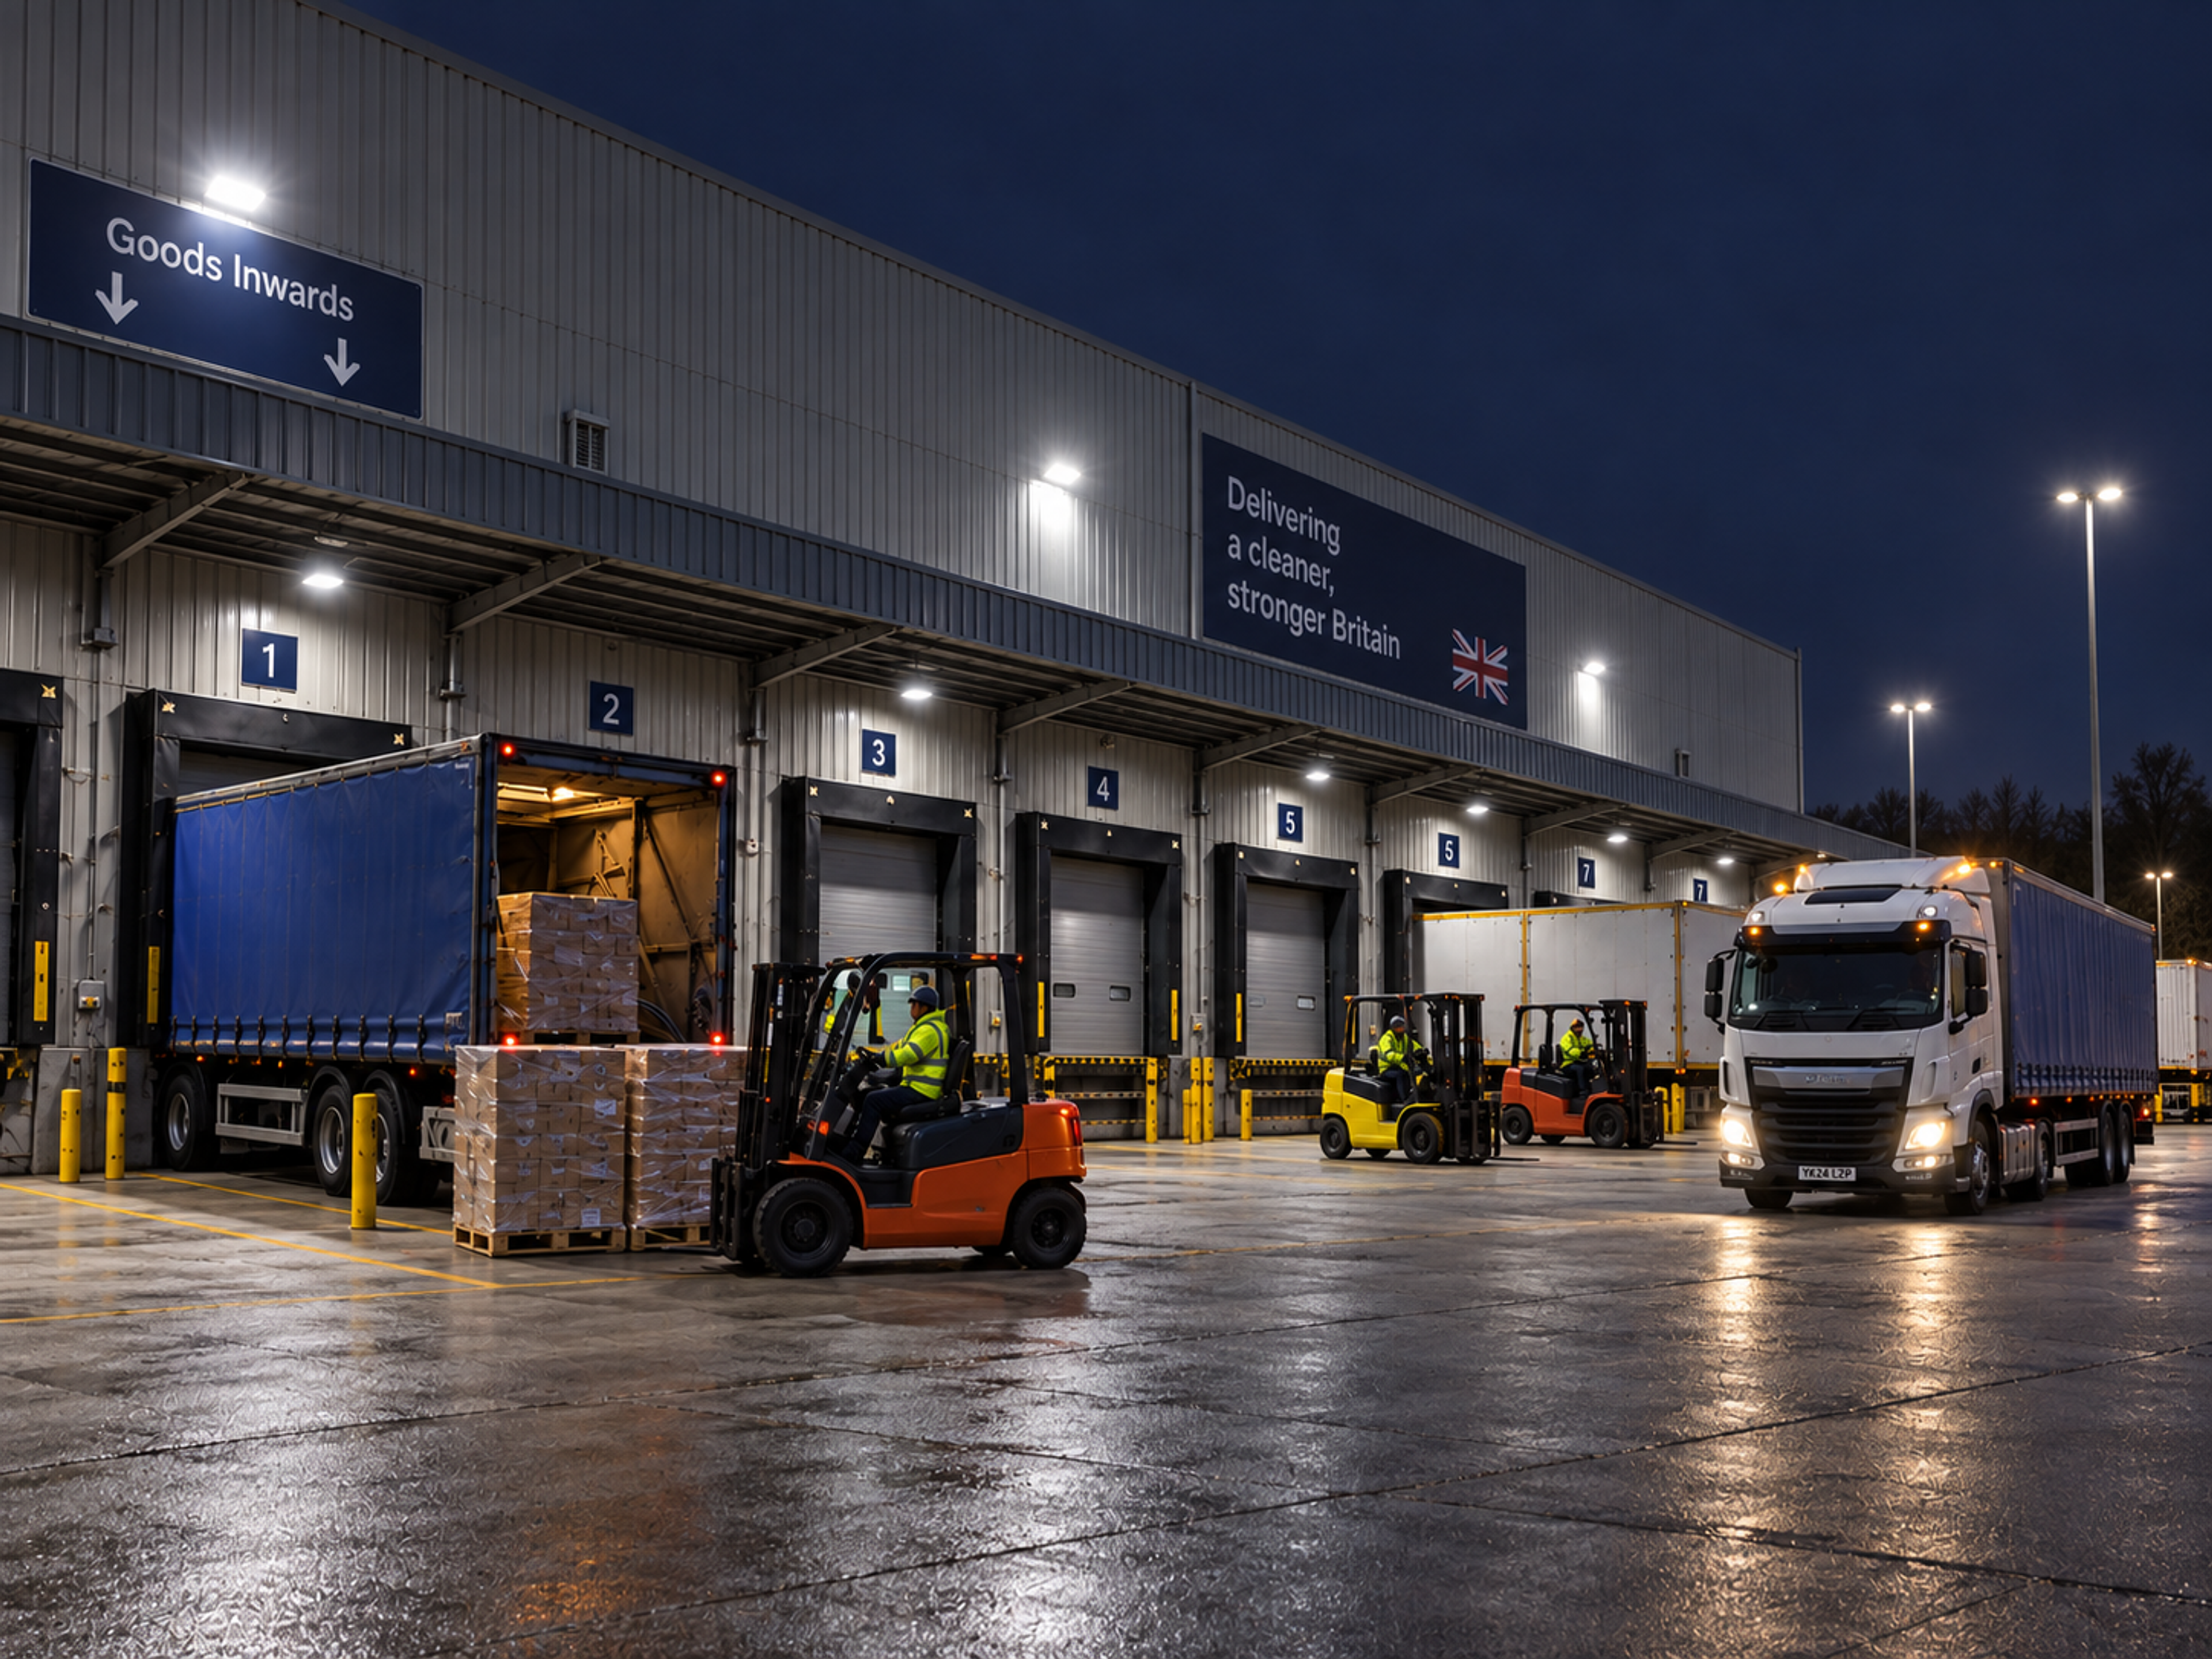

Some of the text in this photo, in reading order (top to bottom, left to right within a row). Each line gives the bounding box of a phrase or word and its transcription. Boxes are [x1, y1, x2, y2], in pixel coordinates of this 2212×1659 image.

[107, 218, 354, 321] Goods Inwards
[1228, 476, 1340, 556] Delivering
[1228, 533, 1335, 597] a cleaner,
[1228, 580, 1400, 660] stronger Britain
[263, 642, 275, 678] 1
[603, 693, 619, 725] 2
[872, 738, 886, 767] 3
[1096, 776, 1110, 802] 4
[1285, 810, 1295, 835] 5
[1583, 863, 1590, 882] 7
[1697, 884, 1703, 902] 7
